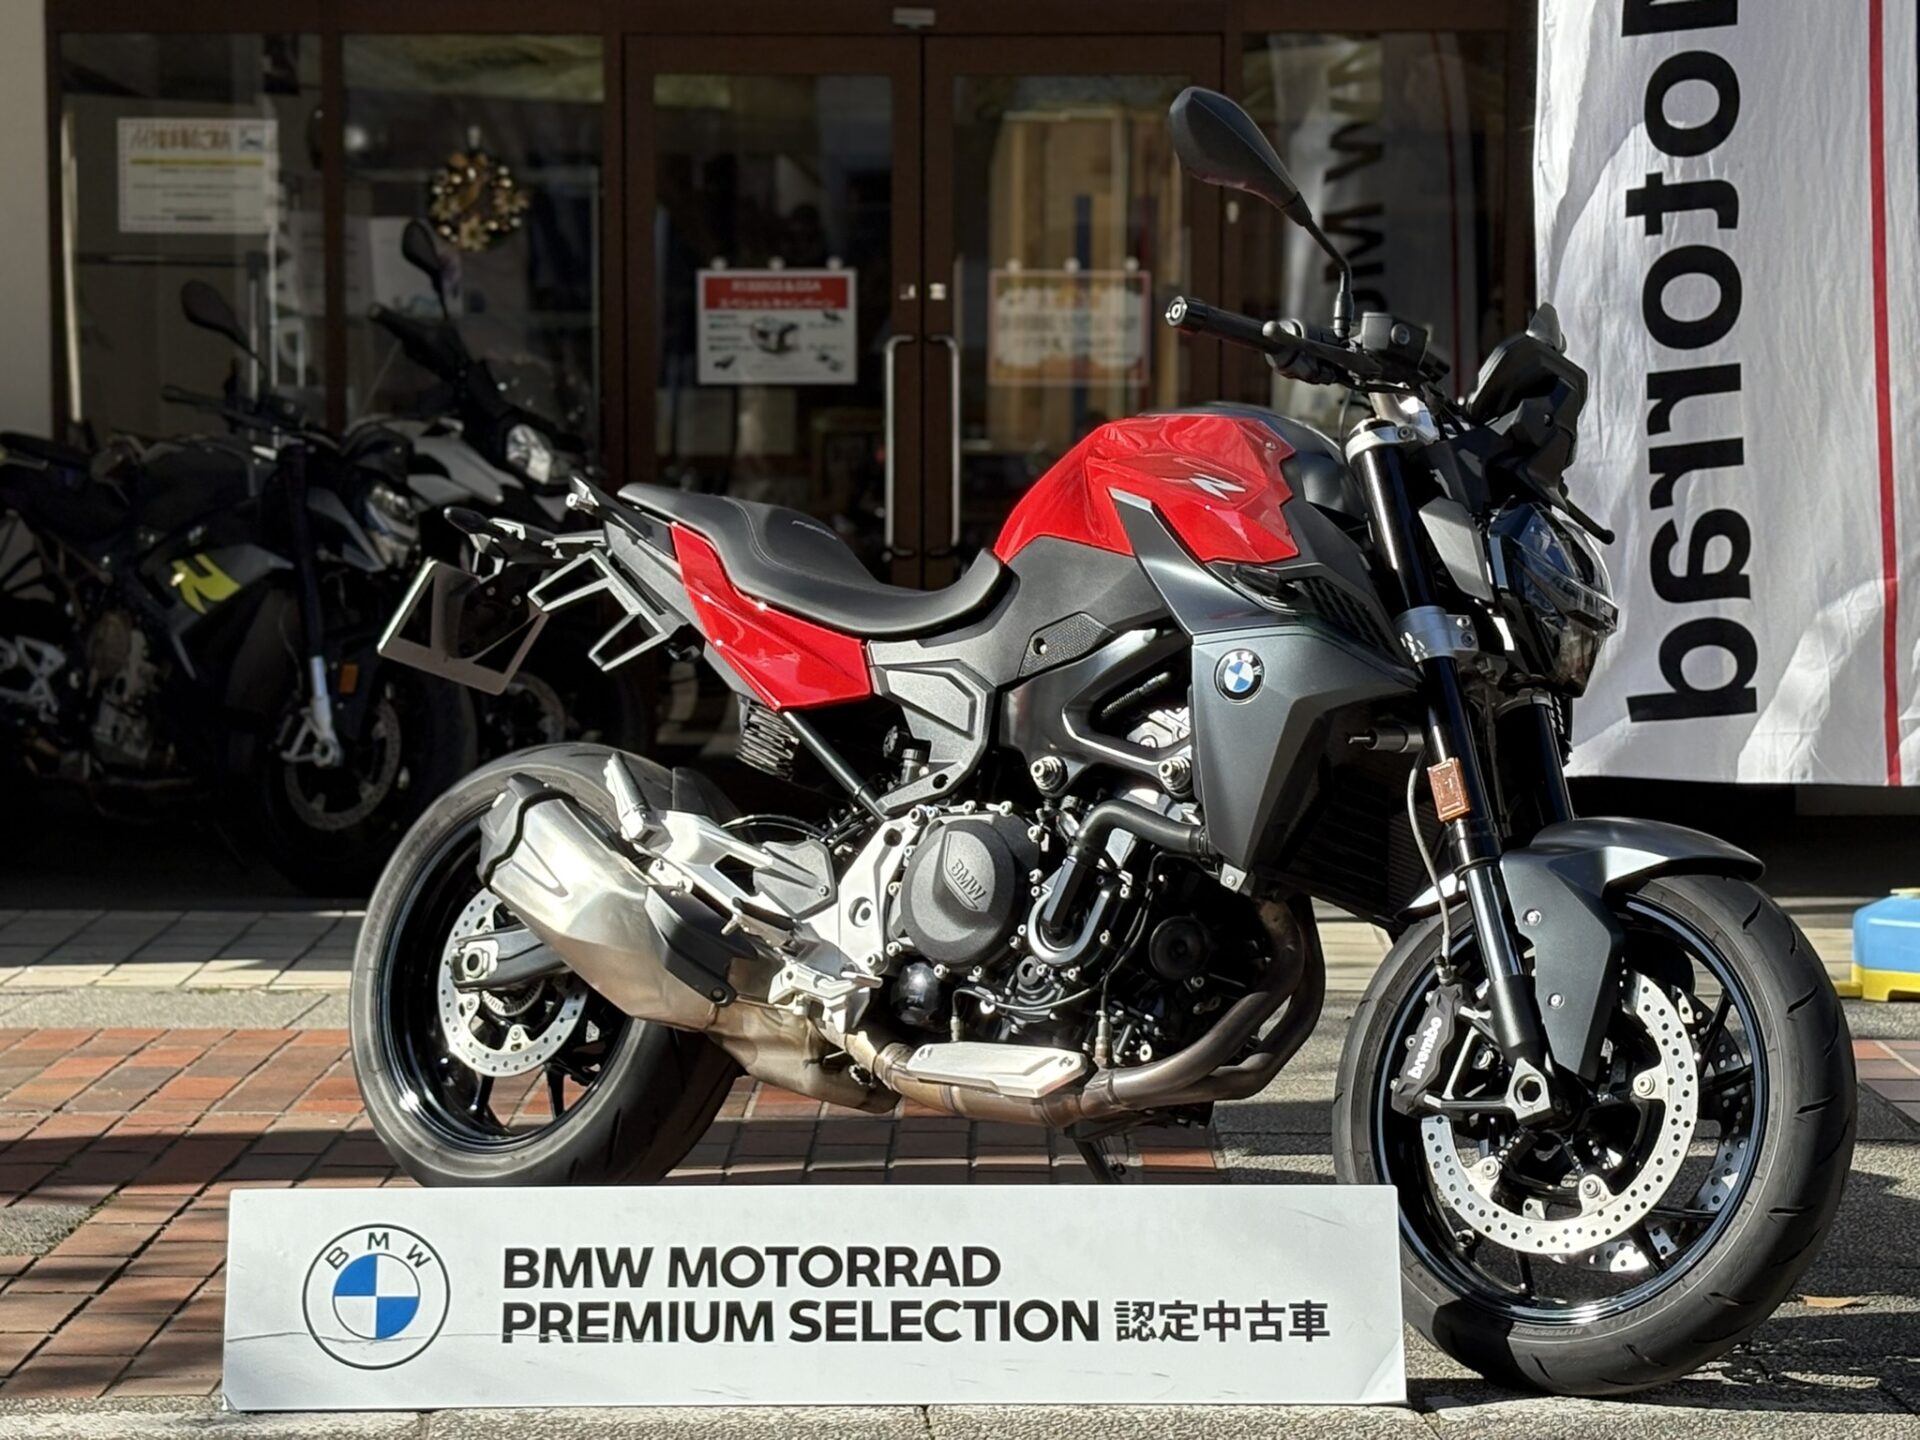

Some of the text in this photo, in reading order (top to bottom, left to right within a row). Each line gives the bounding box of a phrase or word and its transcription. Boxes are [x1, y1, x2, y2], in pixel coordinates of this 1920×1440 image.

[951, 859, 986, 901] BMW
[1407, 1017, 1443, 1079] brembo
[325, 1231, 432, 1270] BMW
[504, 1244, 1001, 1288] BMW MOTORRAD
[502, 1299, 1330, 1343] PREMIUM SELECTION 認定中古車
